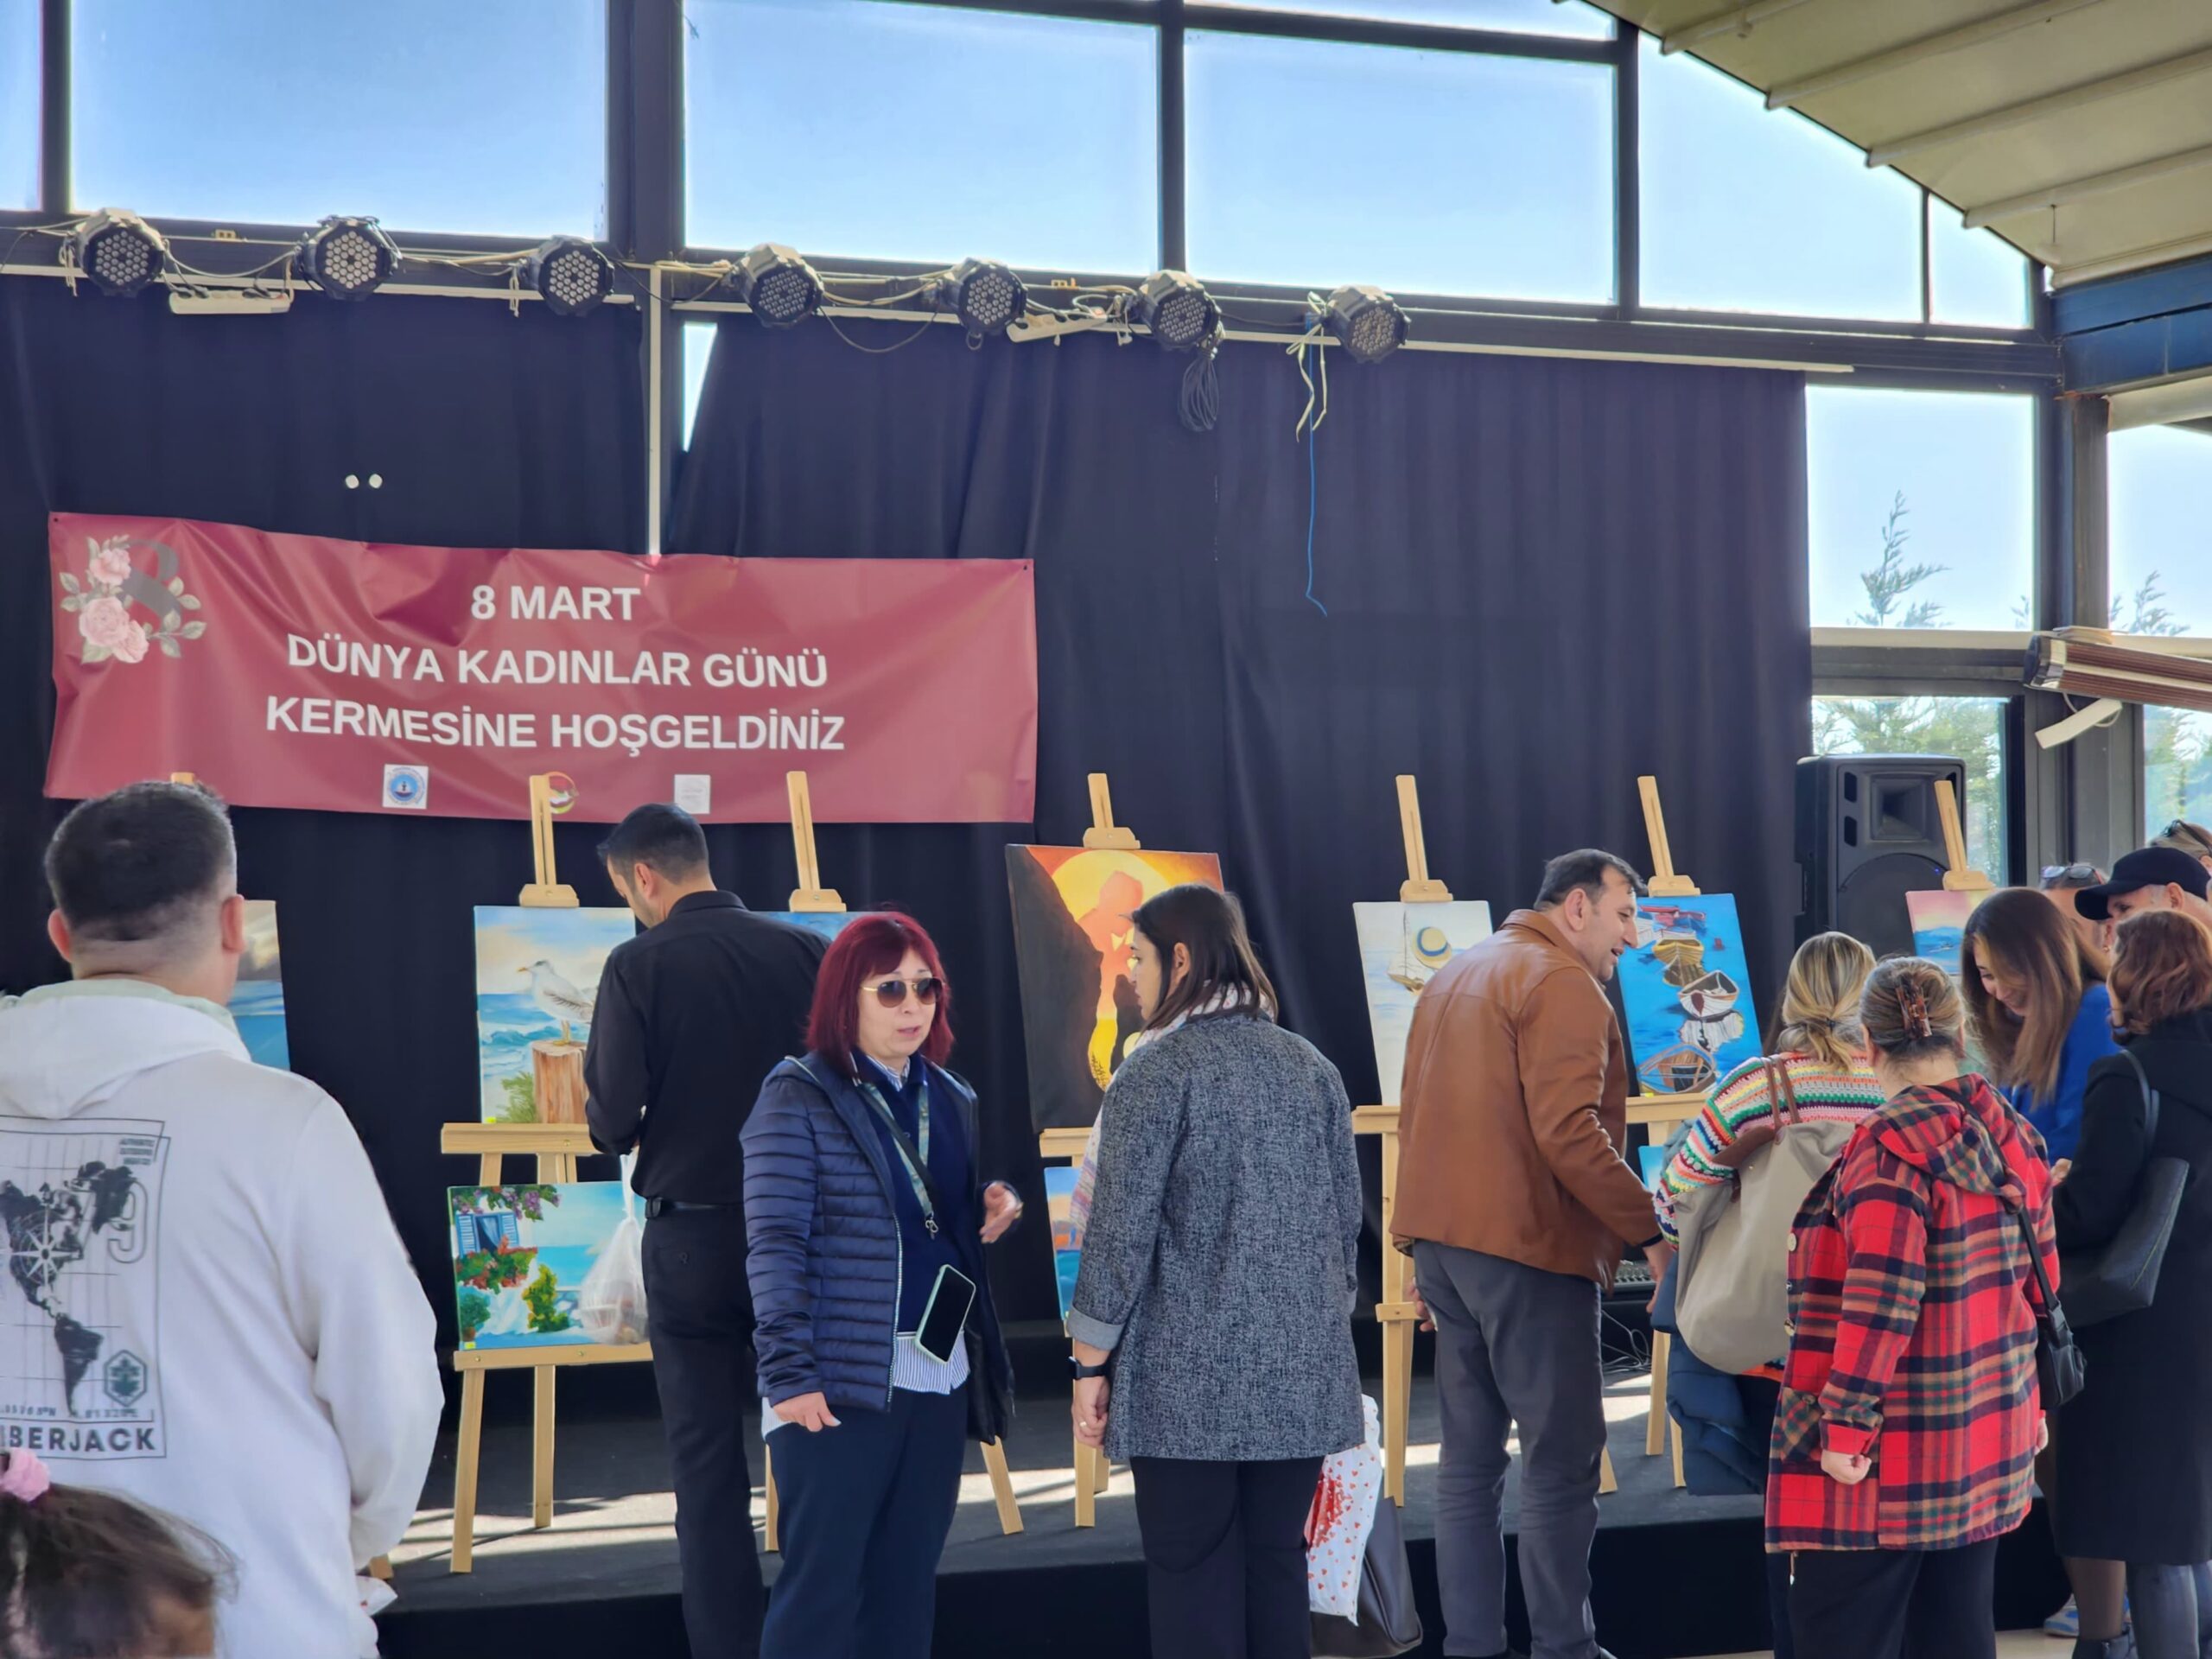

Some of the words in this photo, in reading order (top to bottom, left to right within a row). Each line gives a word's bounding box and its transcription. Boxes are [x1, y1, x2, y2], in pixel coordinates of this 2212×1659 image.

[471, 585, 497, 620] 8
[510, 586, 641, 620] MART
[287, 632, 444, 683] DÜNYA
[458, 649, 691, 685] KADINLAR
[702, 647, 828, 688] GÜNÜ
[266, 695, 537, 747] KERMESİNE
[551, 708, 845, 758] HOŞGELDİNİZ
[0, 1425, 155, 1452] BERJACK
